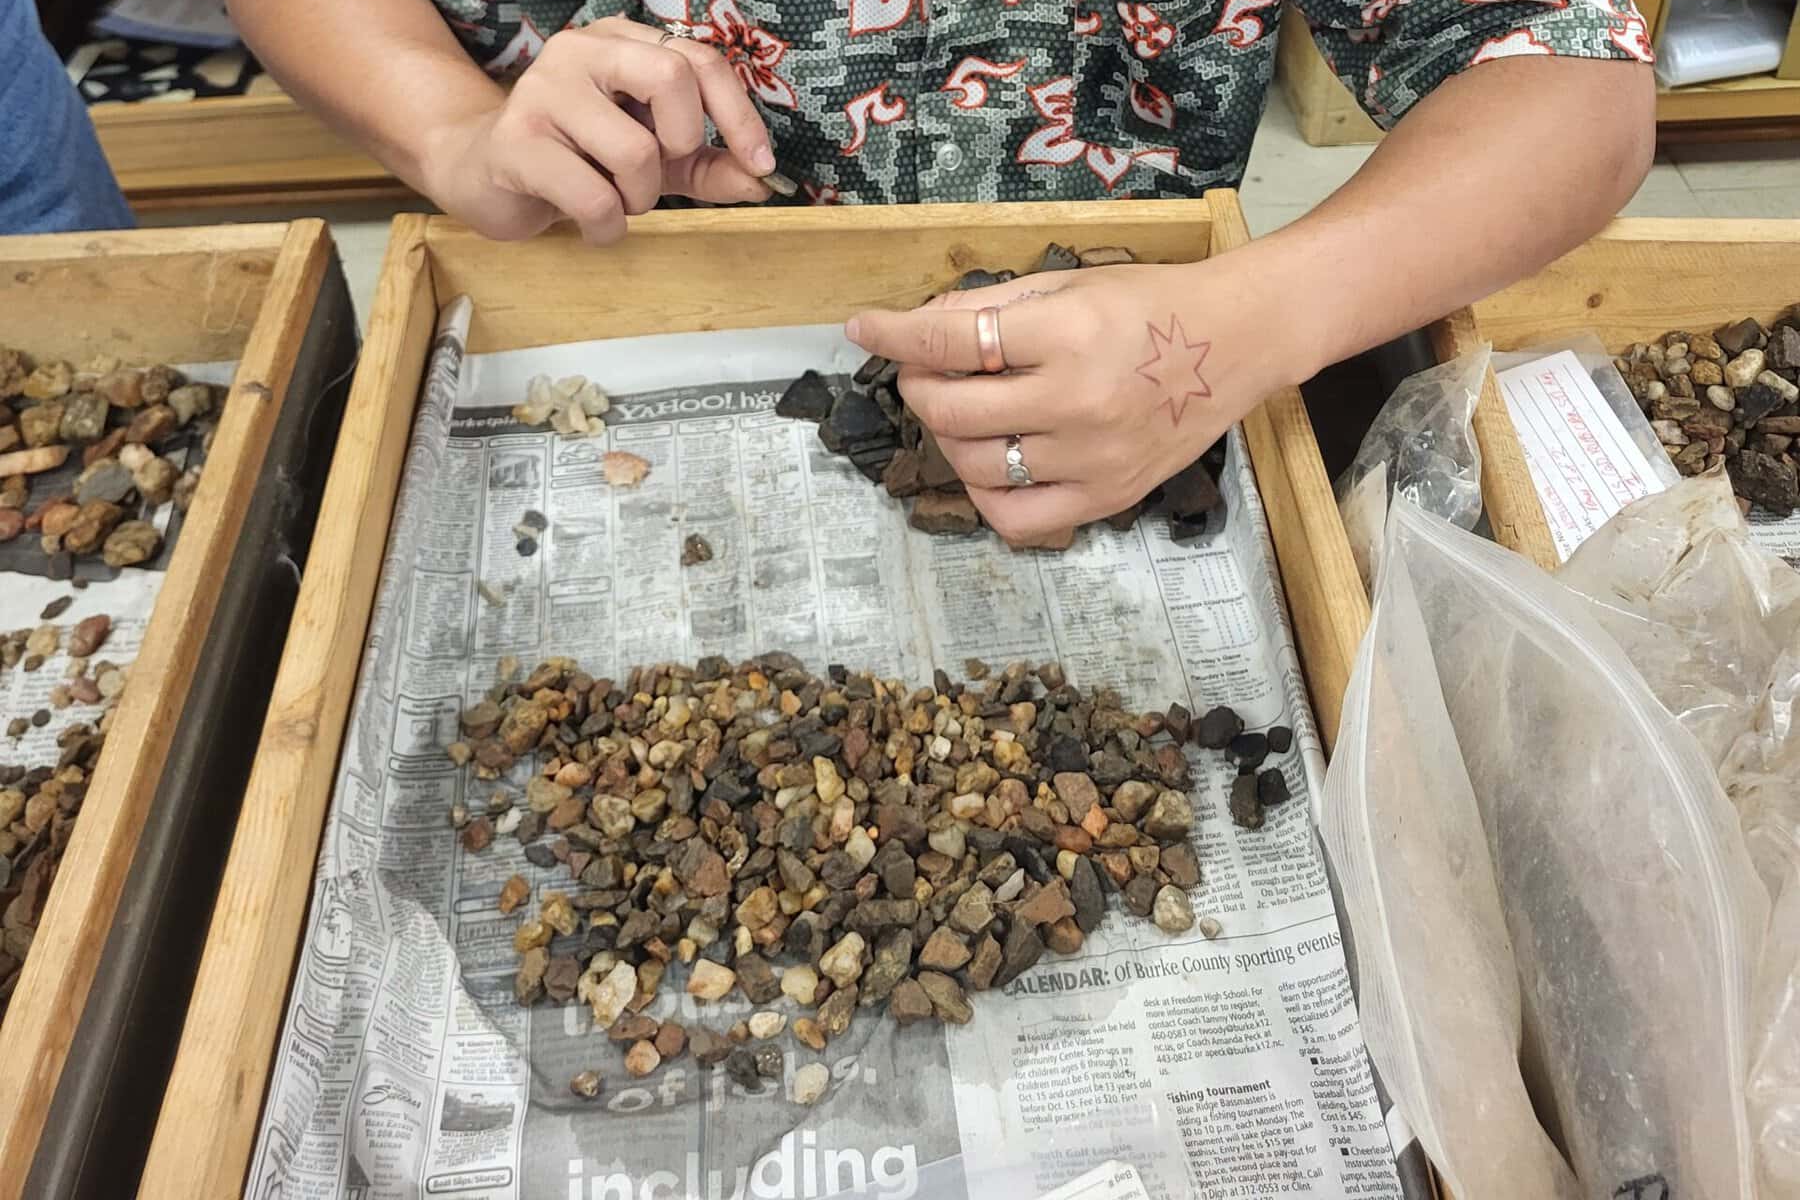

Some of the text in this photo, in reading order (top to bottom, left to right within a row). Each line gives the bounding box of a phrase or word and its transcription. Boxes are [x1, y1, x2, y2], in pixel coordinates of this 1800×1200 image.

[617, 395, 732, 421] YAHOO!
[1261, 888, 1273, 897] On
[1115, 963, 1131, 983] Of
[1134, 960, 1178, 979] Burke
[1182, 952, 1231, 975] County
[1235, 943, 1296, 972] sporting
[1298, 932, 1340, 957] events
[1278, 983, 1295, 992] offer
[1281, 984, 1336, 1003] learn the game
[1144, 987, 1263, 1007] desk at Freedom High School. For
[1285, 1004, 1300, 1013] well
[1313, 996, 1333, 1008] refine
[1146, 1000, 1260, 1018] more information or to register,
[1148, 1020, 1176, 1030] contact
[1177, 1016, 1201, 1027] Coach
[1202, 1014, 1228, 1026] Tammy
[1230, 1011, 1255, 1023] Woody
[1288, 1011, 1329, 1024] specialized
[1119, 1022, 1136, 1030] held
[1152, 1029, 1187, 1040] 460-0583
[1177, 1042, 1185, 1050] or
[1187, 1038, 1211, 1049] Coach
[1212, 1034, 1243, 1046] Amanda
[1244, 1032, 1261, 1042] Peck
[1303, 1033, 1336, 1044] 9 to
[1157, 1051, 1193, 1063] 443-0822
[1299, 1046, 1323, 1057] grade.
[1028, 1058, 1118, 1078] children through
[1314, 1066, 1348, 1077] Campers
[1017, 1071, 1111, 1091] Children years
[1048, 1079, 1152, 1098] and cannot years old
[1206, 1080, 1272, 1097] tournament
[1311, 1074, 1362, 1089] coaching staff
[608, 1068, 686, 1113] of
[1313, 1089, 1345, 1099] baseball
[1176, 1093, 1276, 1115] Blue Ridge Bassmasters is
[1210, 1111, 1236, 1122] fishing
[1238, 1103, 1283, 1118] tournament
[1285, 1099, 1304, 1108] from
[1317, 1100, 1368, 1110] fielding, base
[1194, 1111, 1304, 1136] to 10 p.m. each The
[1320, 1112, 1339, 1121] Cost
[1226, 1133, 1240, 1144] will
[1242, 1130, 1259, 1141] take
[1260, 1128, 1282, 1139] place
[1295, 1120, 1313, 1132] Lake
[1333, 1123, 1367, 1132] 9 a.m. to
[1220, 1137, 1295, 1154] Entry fee is $15 per
[1329, 1136, 1351, 1147] grade
[1214, 1154, 1237, 1166] There
[1238, 1152, 1252, 1162] will
[1254, 1150, 1264, 1160] be
[1274, 1148, 1304, 1160] pay-out
[1306, 1145, 1317, 1154] for
[1345, 1158, 1386, 1168] Instruction
[567, 1129, 919, 1200] including
[1229, 1159, 1298, 1173] second place and
[1115, 1170, 1133, 1183] Bag
[1222, 1168, 1323, 1184] fish caught per night. Call
[1341, 1171, 1394, 1183] jumps, stunts,
[1209, 1182, 1311, 1200] Digh at 312-0553 or Clint
[1345, 1185, 1361, 1194] and
